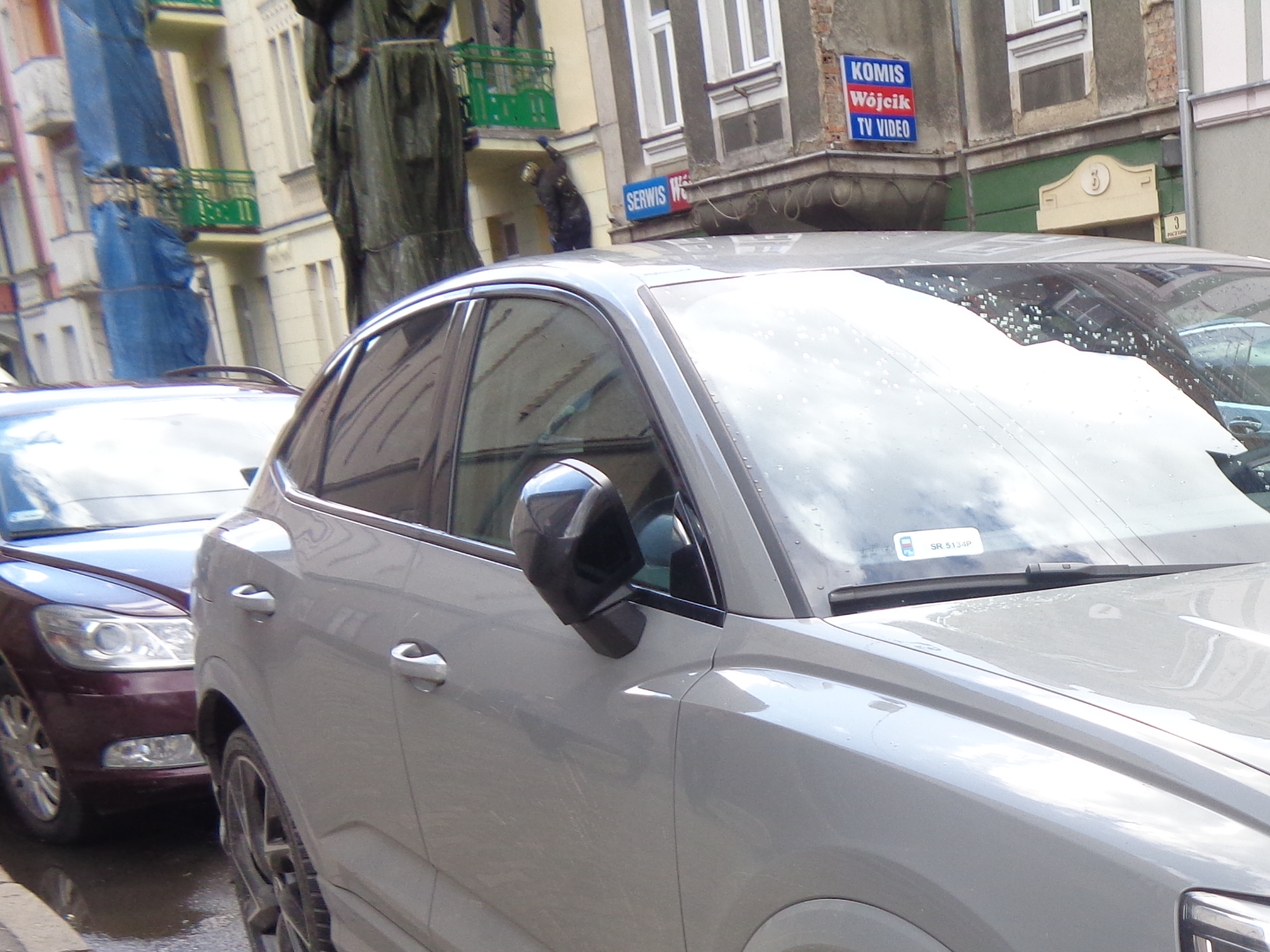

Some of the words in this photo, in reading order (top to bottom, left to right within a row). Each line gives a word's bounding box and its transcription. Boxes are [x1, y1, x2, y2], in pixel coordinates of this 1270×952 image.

[851, 62, 905, 83] KOMIS
[850, 91, 911, 112] Wójcik
[857, 117, 873, 136] TV
[876, 119, 911, 138] VIDEO
[1090, 169, 1101, 191] 3
[626, 185, 667, 212] SERWIS
[1173, 216, 1180, 230] 3
[930, 543, 943, 551] SR
[945, 540, 972, 550] 5134P
